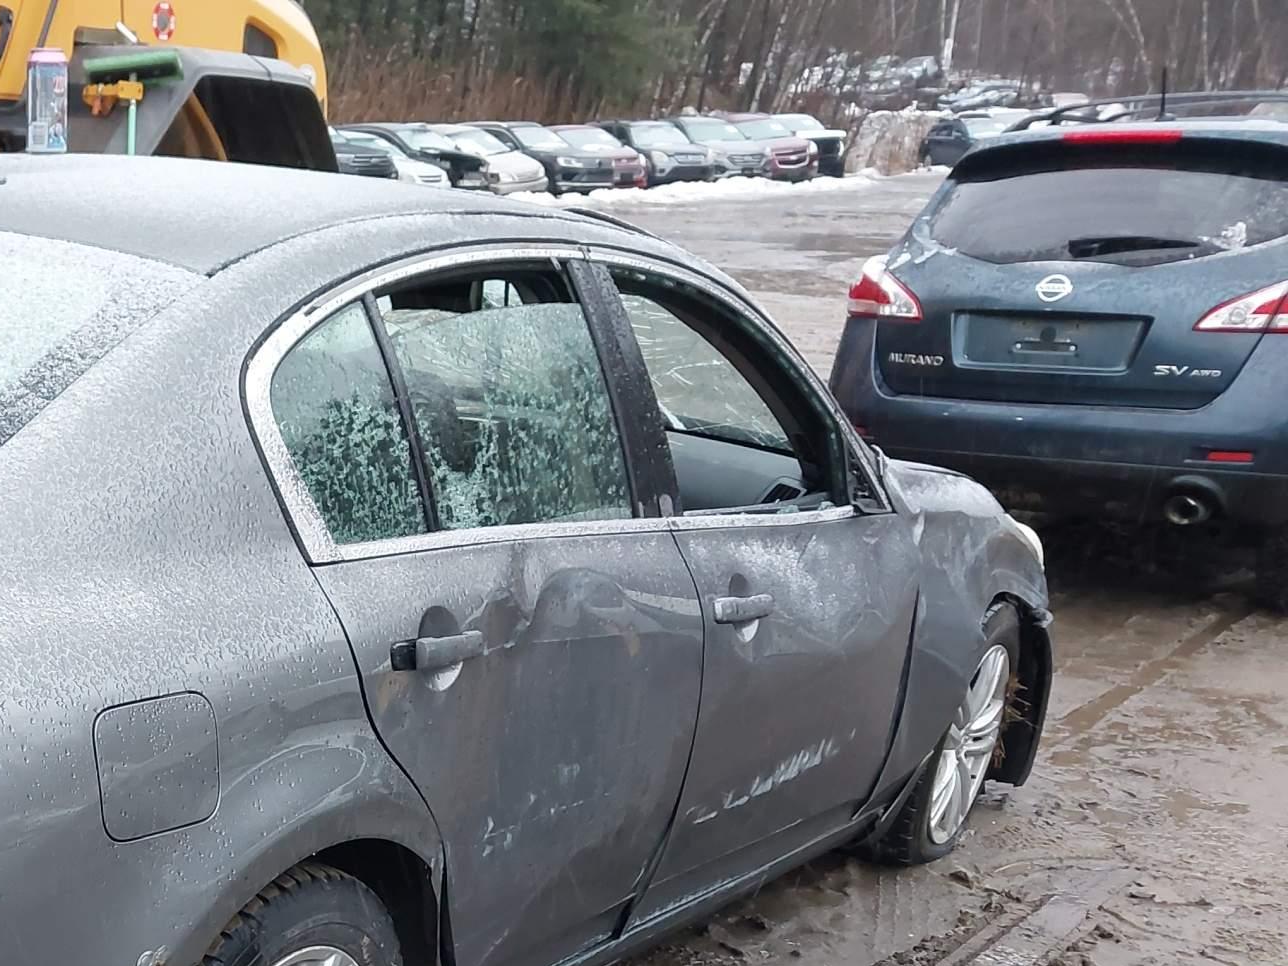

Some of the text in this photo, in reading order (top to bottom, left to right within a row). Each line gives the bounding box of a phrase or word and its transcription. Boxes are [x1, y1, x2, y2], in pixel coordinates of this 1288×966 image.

[888, 352, 944, 366] MURANO
[1153, 365, 1222, 377] SV AWD
